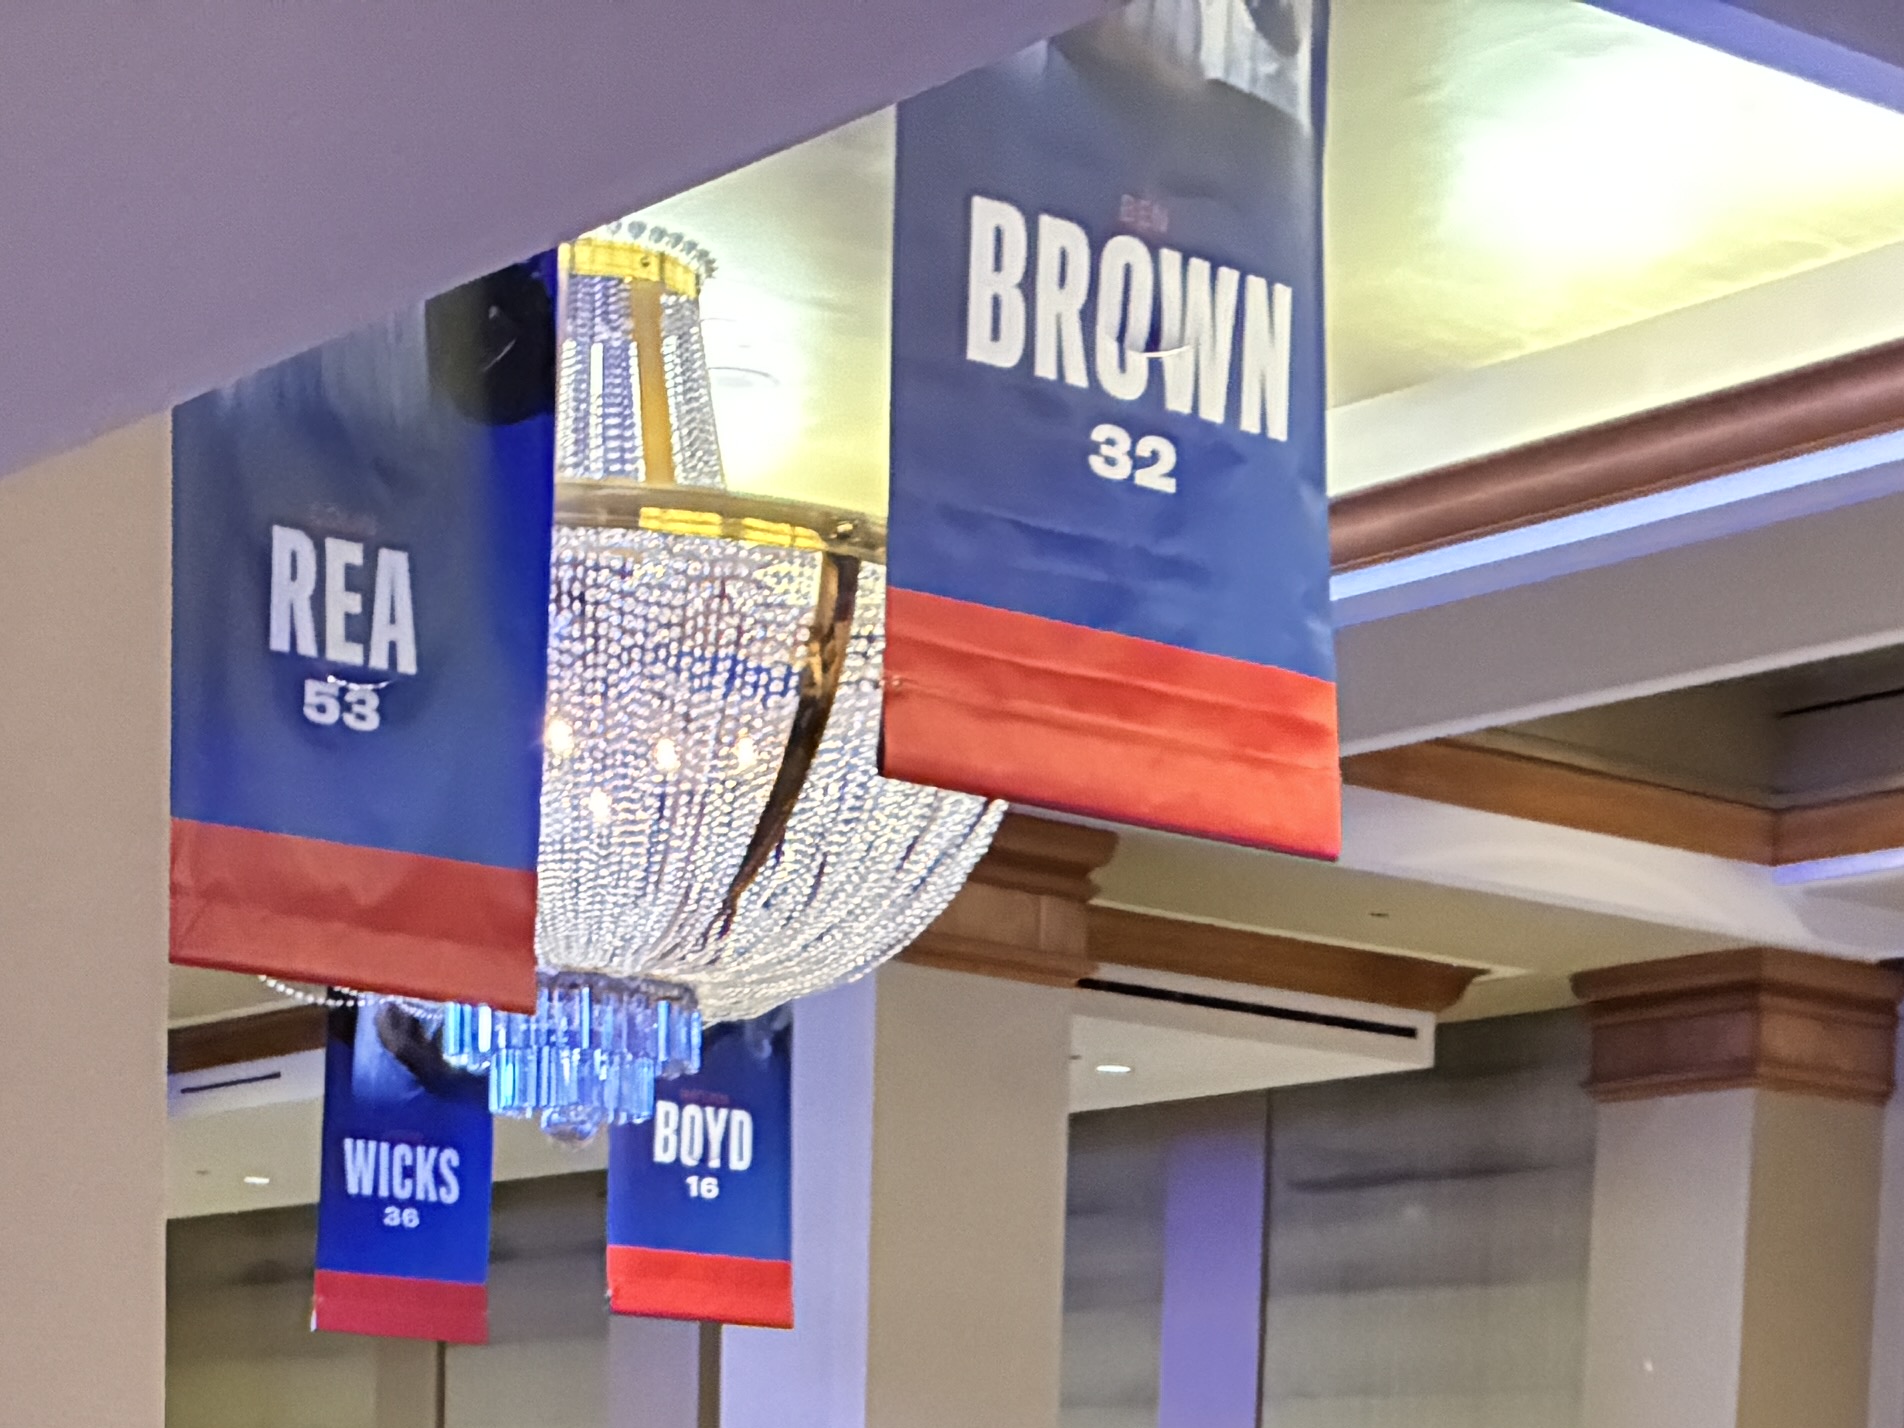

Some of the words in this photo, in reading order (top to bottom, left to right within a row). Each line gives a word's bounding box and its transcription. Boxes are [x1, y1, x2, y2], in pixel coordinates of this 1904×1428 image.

[965, 195, 1291, 441] BROWN
[1088, 424, 1179, 494] 32
[269, 523, 418, 675] REA
[302, 678, 381, 732] 53
[652, 1099, 753, 1171] BOYD
[342, 1137, 460, 1204] WICKS
[685, 1175, 720, 1199] 16
[383, 1205, 420, 1228] 36
